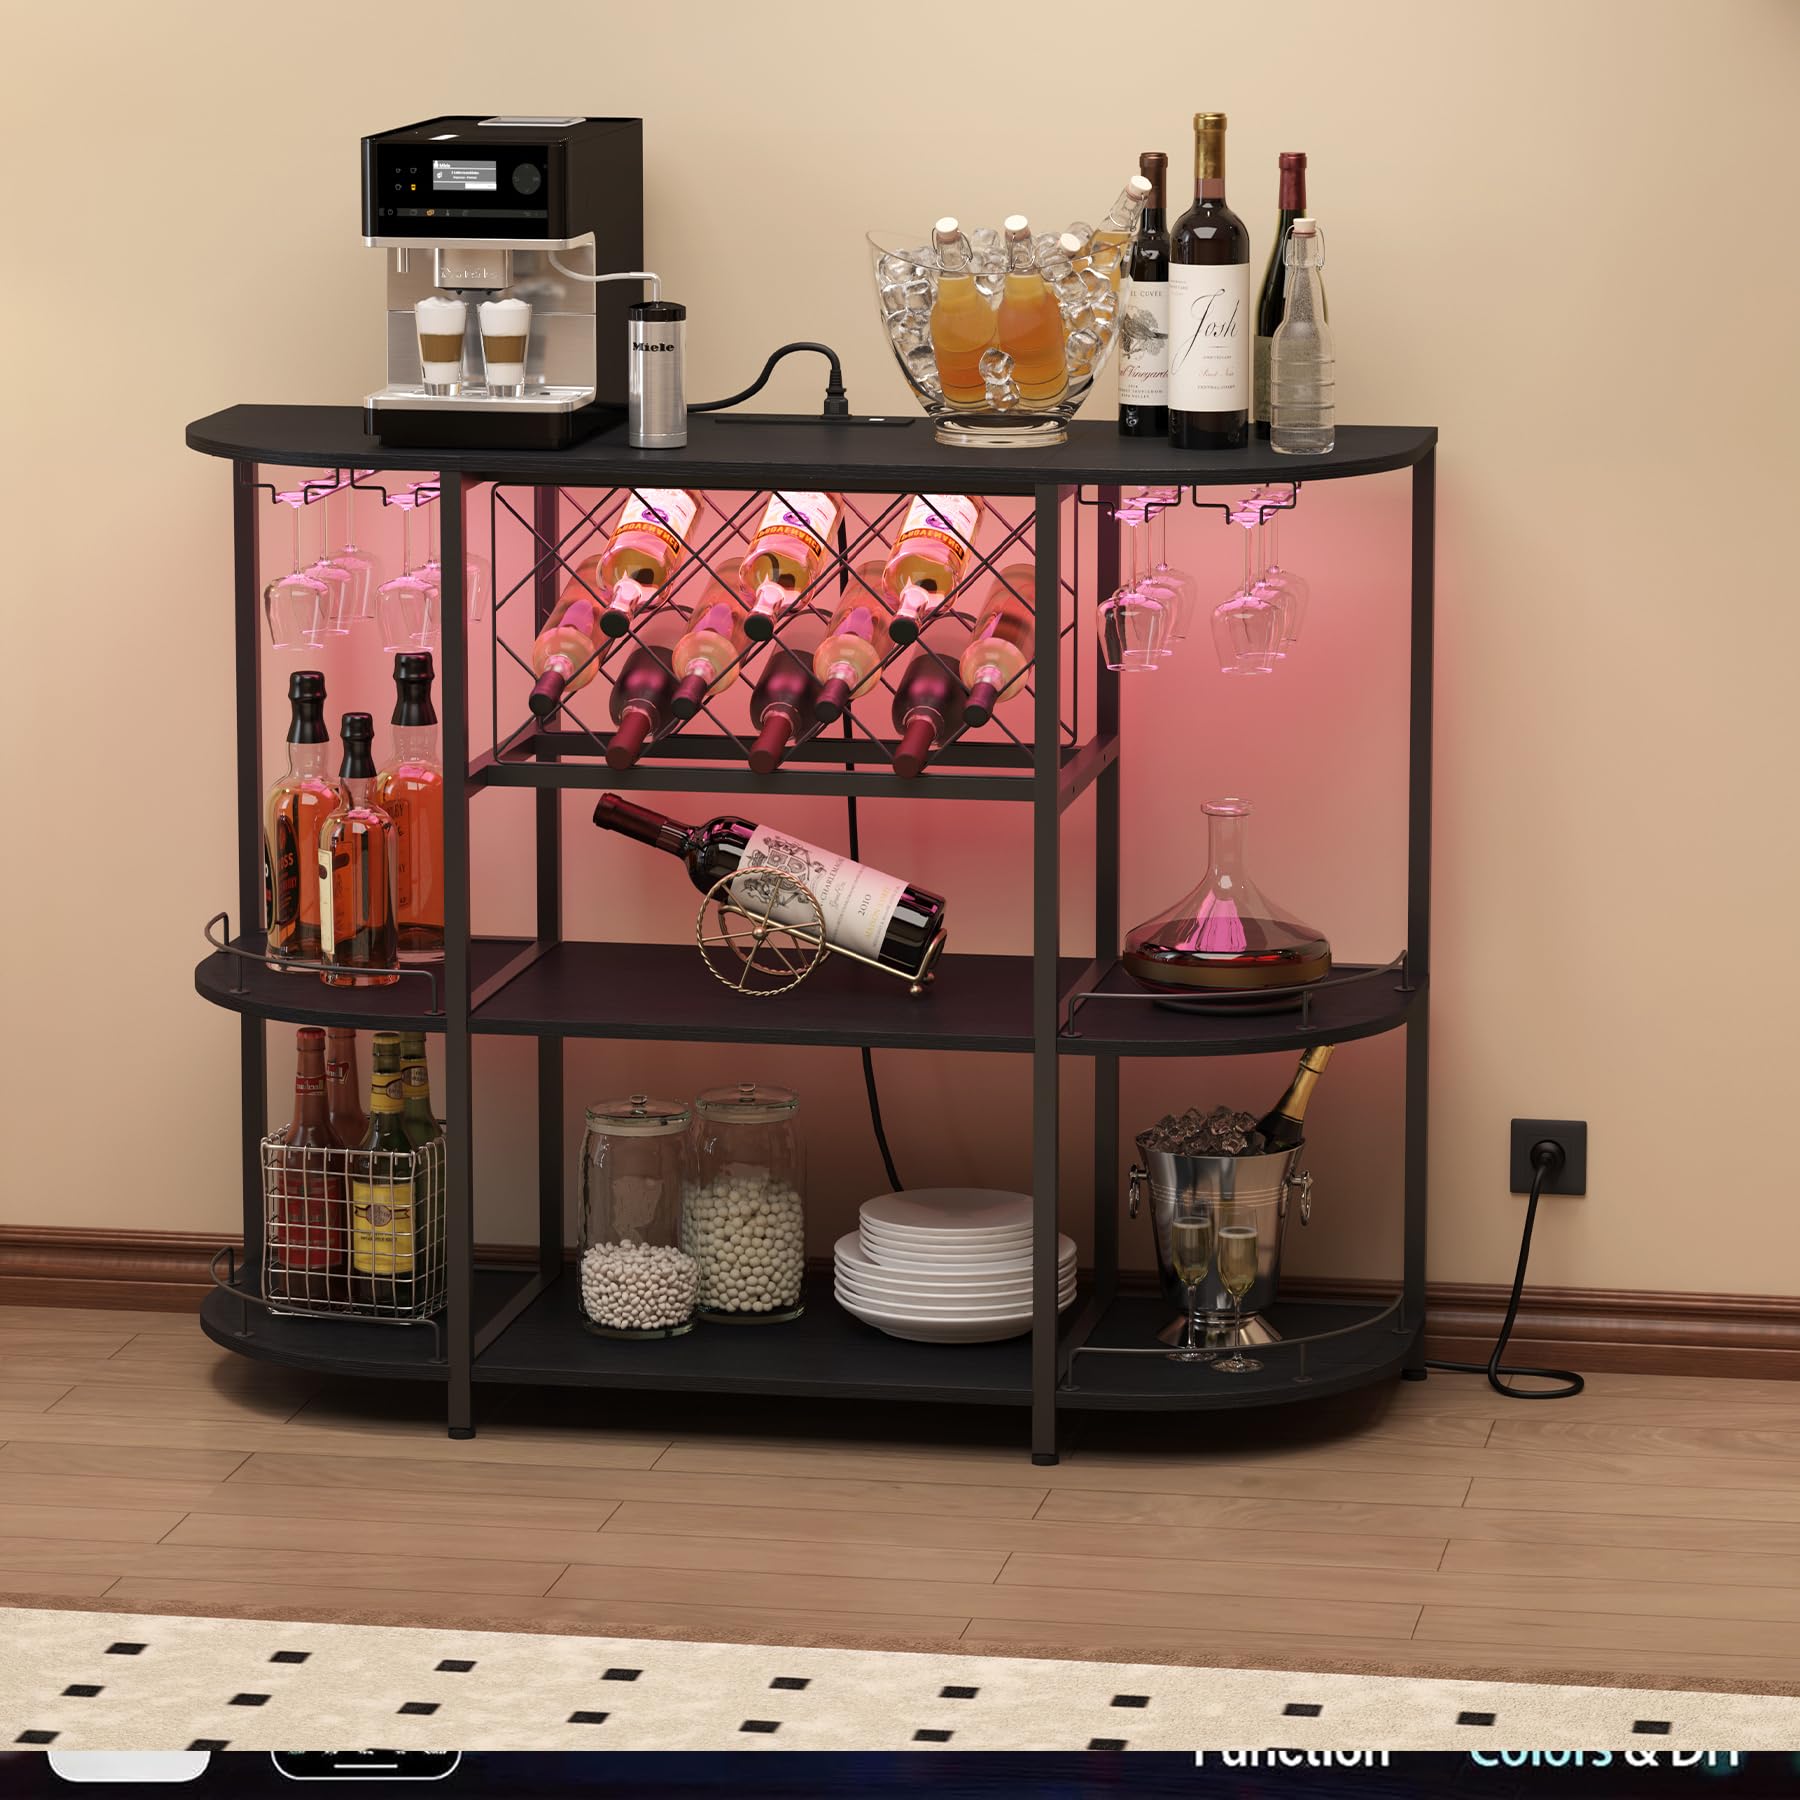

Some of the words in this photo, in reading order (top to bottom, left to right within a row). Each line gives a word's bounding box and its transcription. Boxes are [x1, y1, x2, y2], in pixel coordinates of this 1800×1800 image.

[1171, 288, 1240, 376] Josh
[633, 341, 675, 352] Miele
[858, 893, 872, 916] 2010
